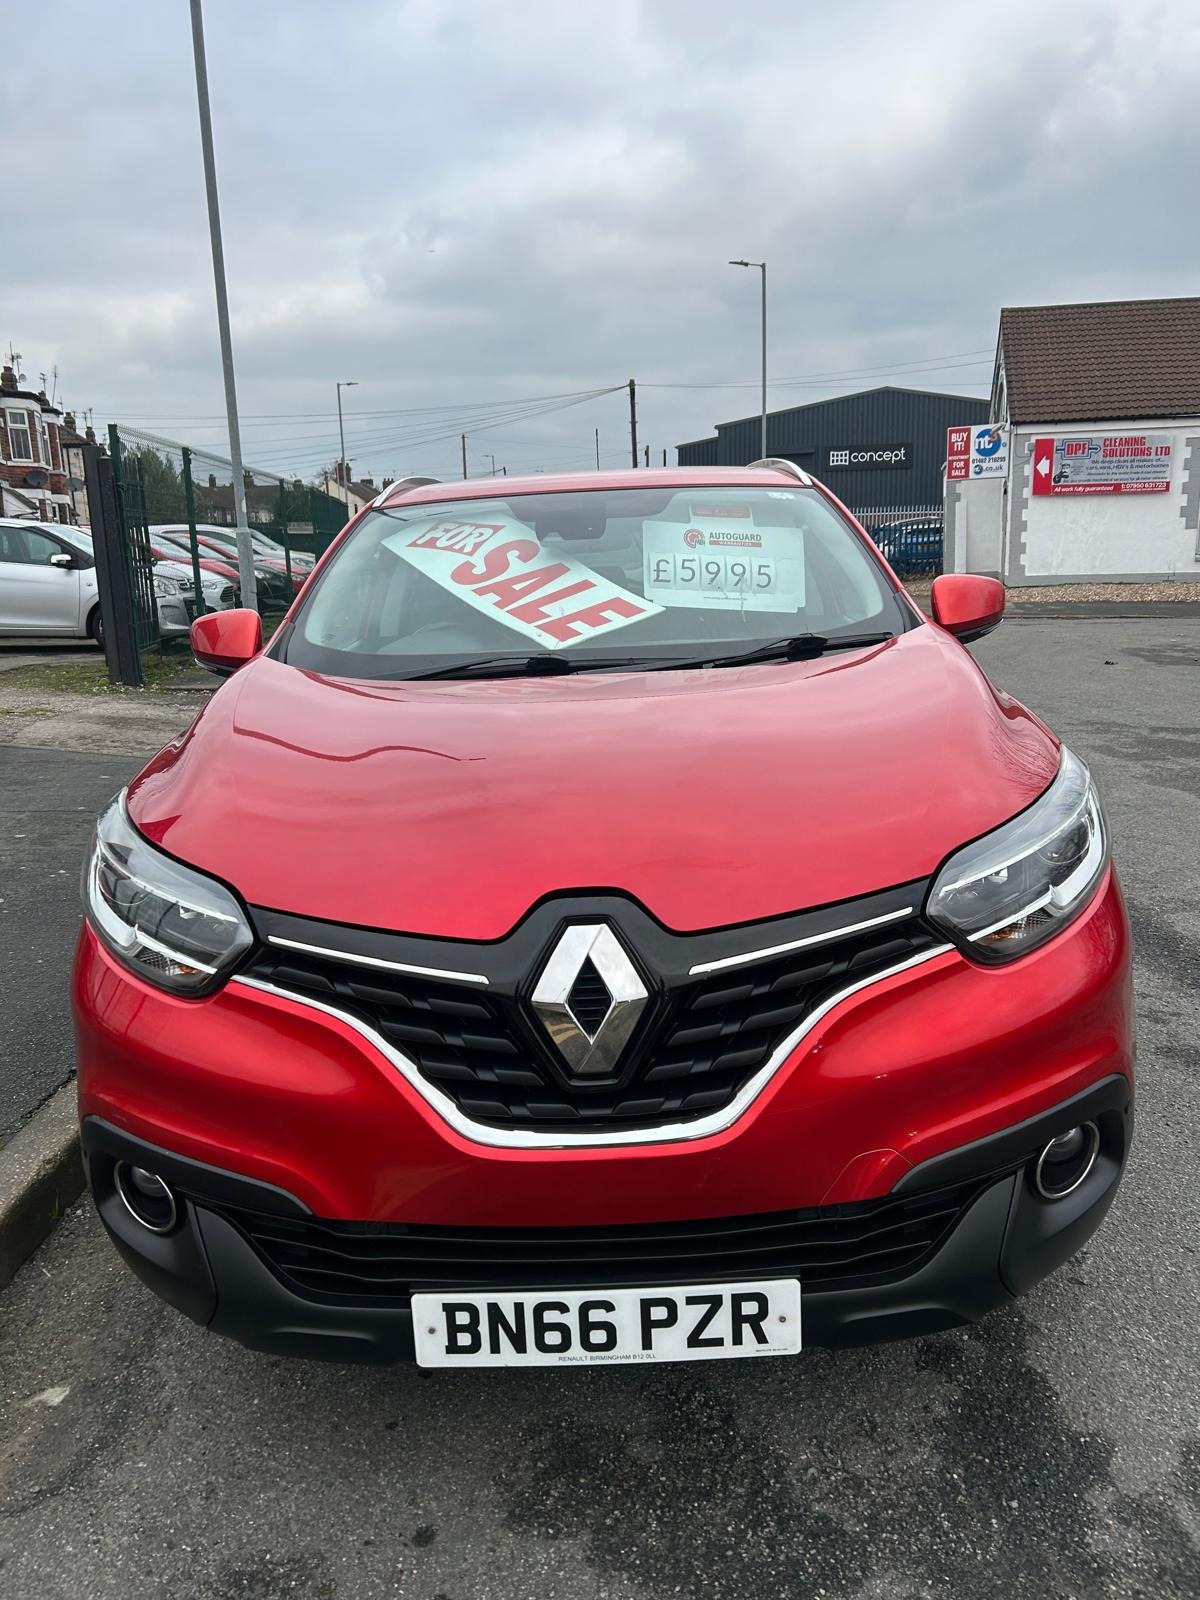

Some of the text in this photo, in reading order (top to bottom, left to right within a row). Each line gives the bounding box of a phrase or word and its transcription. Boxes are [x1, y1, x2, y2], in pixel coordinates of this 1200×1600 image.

[952, 432, 968, 442] BUY
[1103, 437, 1146, 448] CLEANING
[954, 442, 964, 451] IT!
[1066, 442, 1088, 456] DPF
[1102, 446, 1171, 458] SOLUTIONS LTD
[850, 447, 906, 464] concept
[416, 522, 495, 553] FOR
[709, 532, 762, 542] AUTOGUARD
[653, 558, 772, 588] £5995
[451, 539, 647, 642] SALE
[442, 1292, 769, 1354] BN66 PZR
